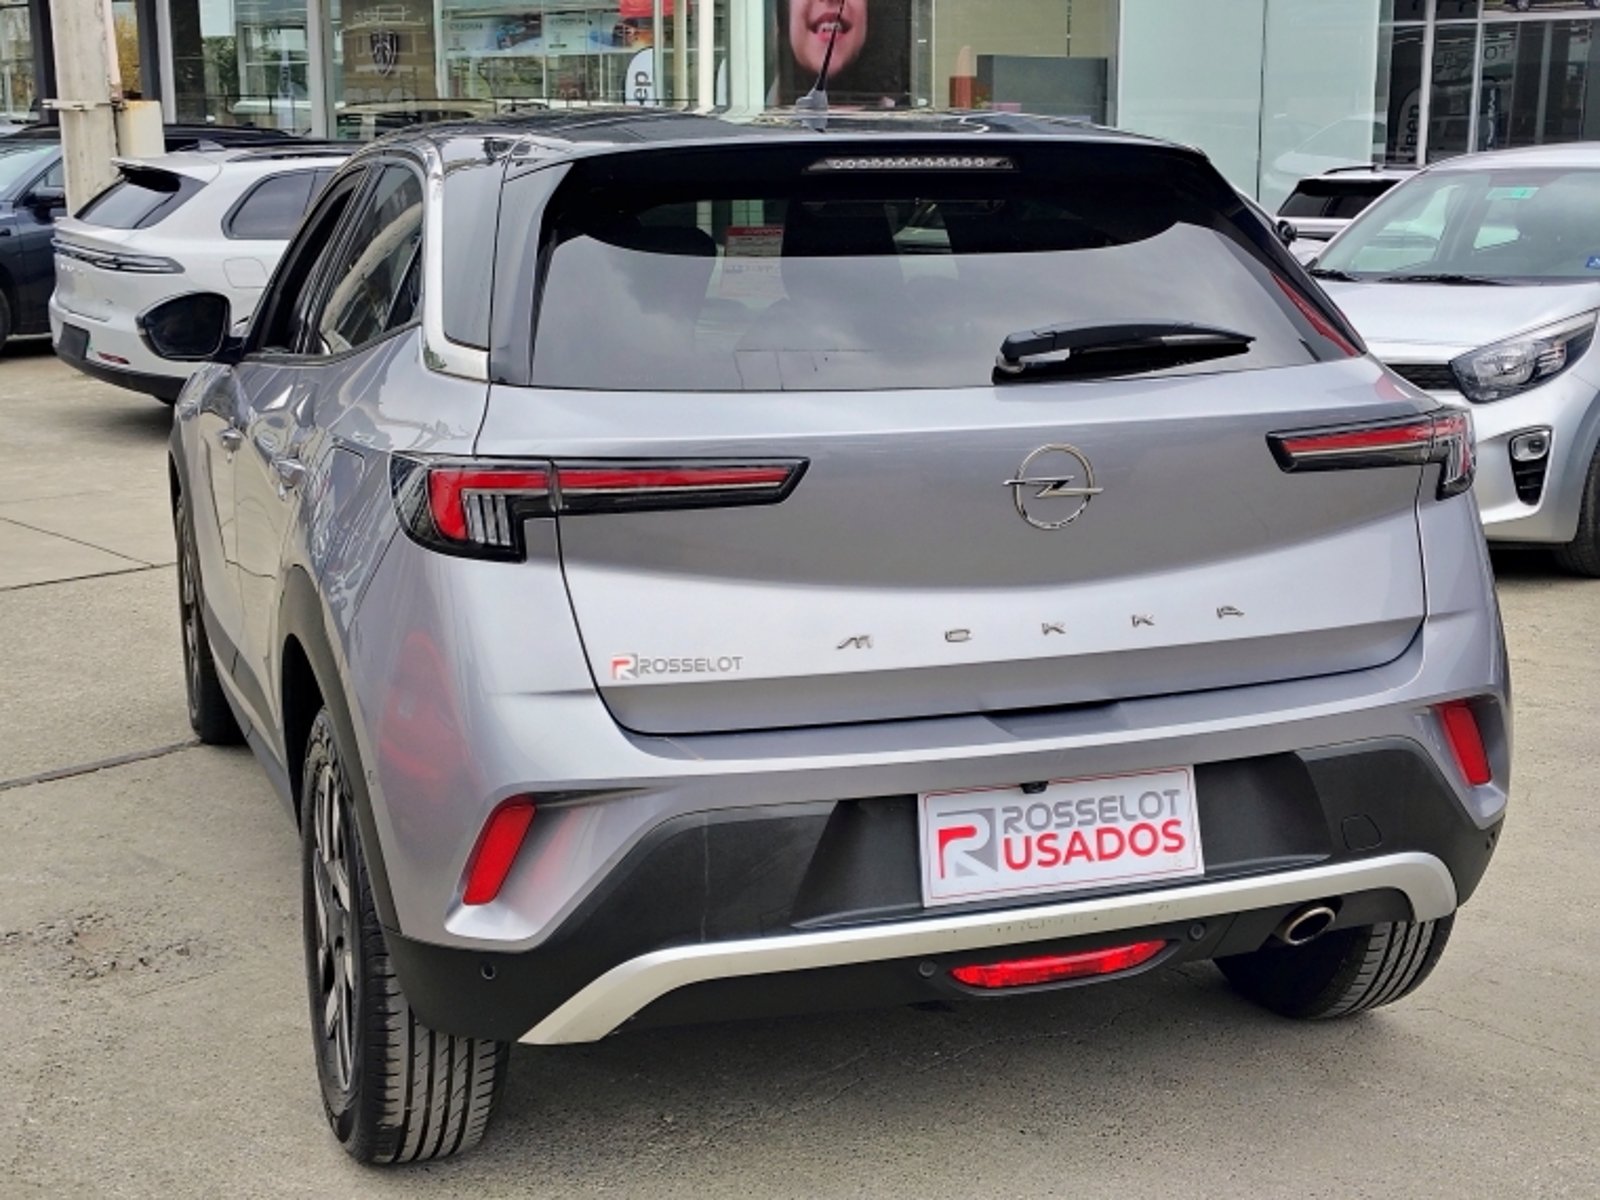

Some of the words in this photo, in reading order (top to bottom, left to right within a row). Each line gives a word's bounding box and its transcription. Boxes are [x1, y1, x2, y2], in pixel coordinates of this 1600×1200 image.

[633, 71, 652, 100] ep
[639, 656, 744, 675] ROSSELOT
[1001, 789, 1181, 834] ROSSELOT
[1003, 819, 1186, 871] USADOS
